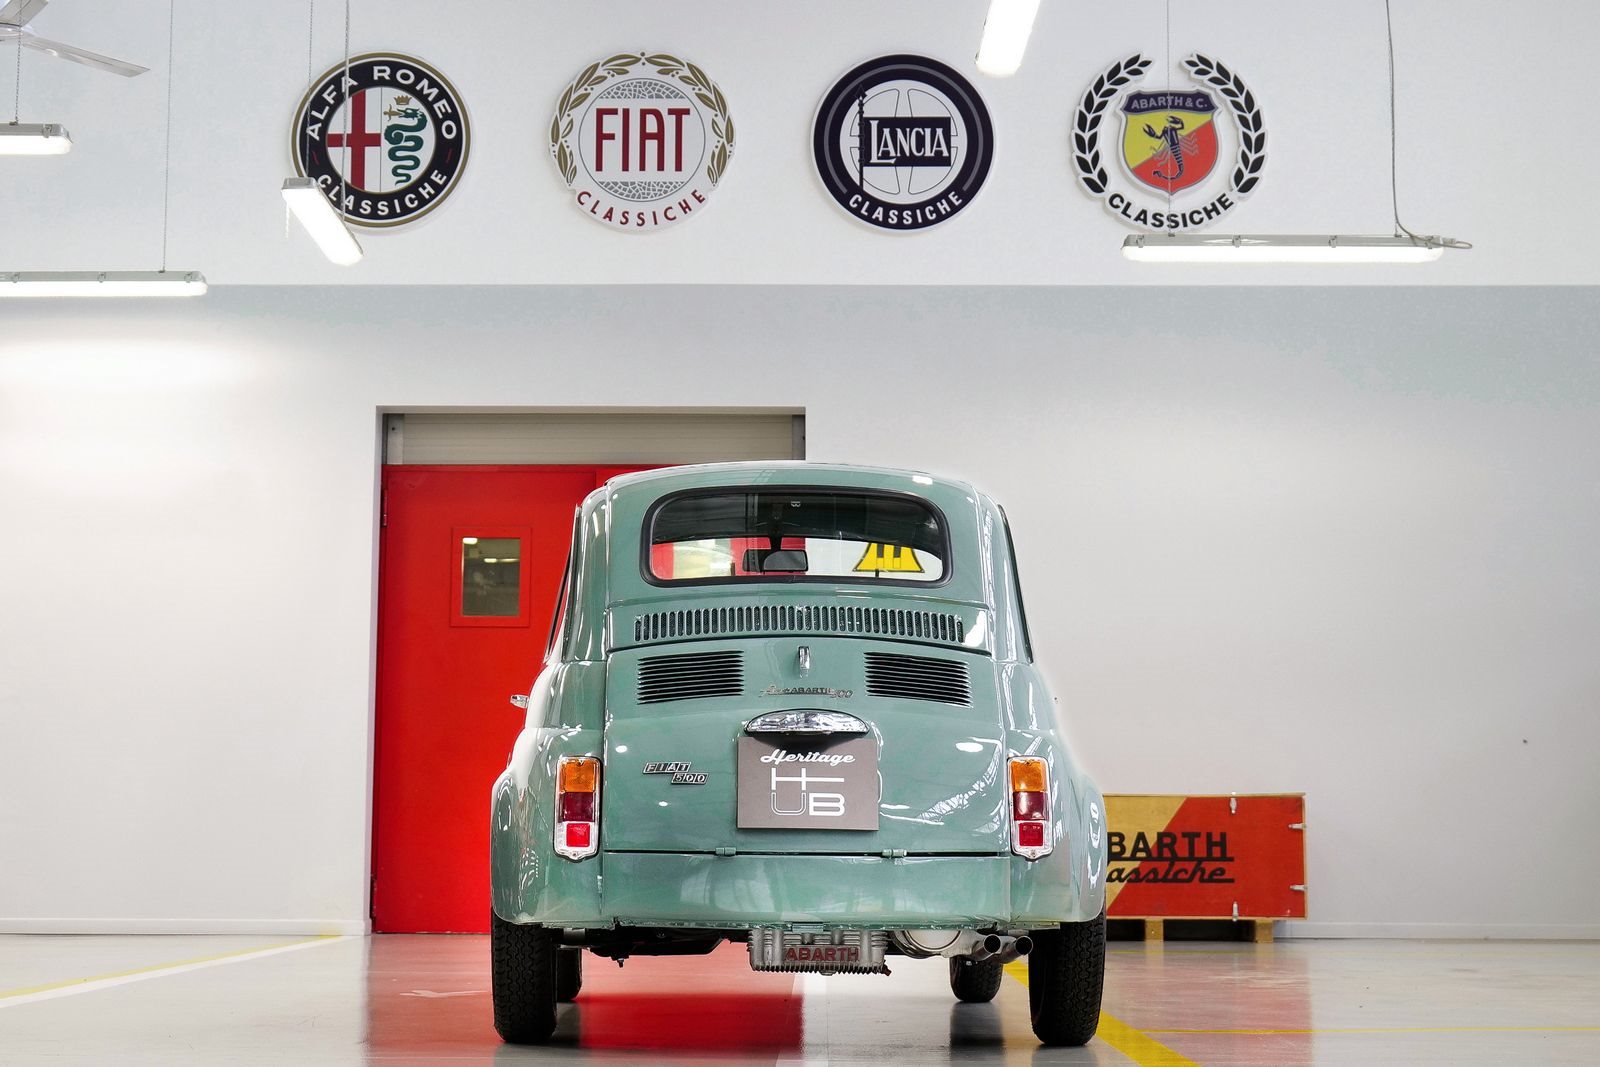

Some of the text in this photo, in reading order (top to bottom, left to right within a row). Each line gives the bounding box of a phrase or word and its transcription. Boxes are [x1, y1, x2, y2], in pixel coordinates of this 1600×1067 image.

[306, 66, 457, 141] ALFA ROMEO
[1131, 96, 1183, 109] ABARTH
[595, 108, 691, 172] FIAT
[317, 170, 447, 216] CLASSICHE
[577, 189, 705, 226] CLASSICHE
[849, 191, 962, 225] CLASSICHE
[1108, 192, 1234, 229] CLASSICHE
[645, 762, 690, 772] FIAT
[760, 749, 856, 767] Heritage
[674, 773, 706, 783] 500
[1106, 831, 1228, 859] BARTH
[1106, 861, 1235, 883] assiche
[785, 947, 859, 962] ABARTH
